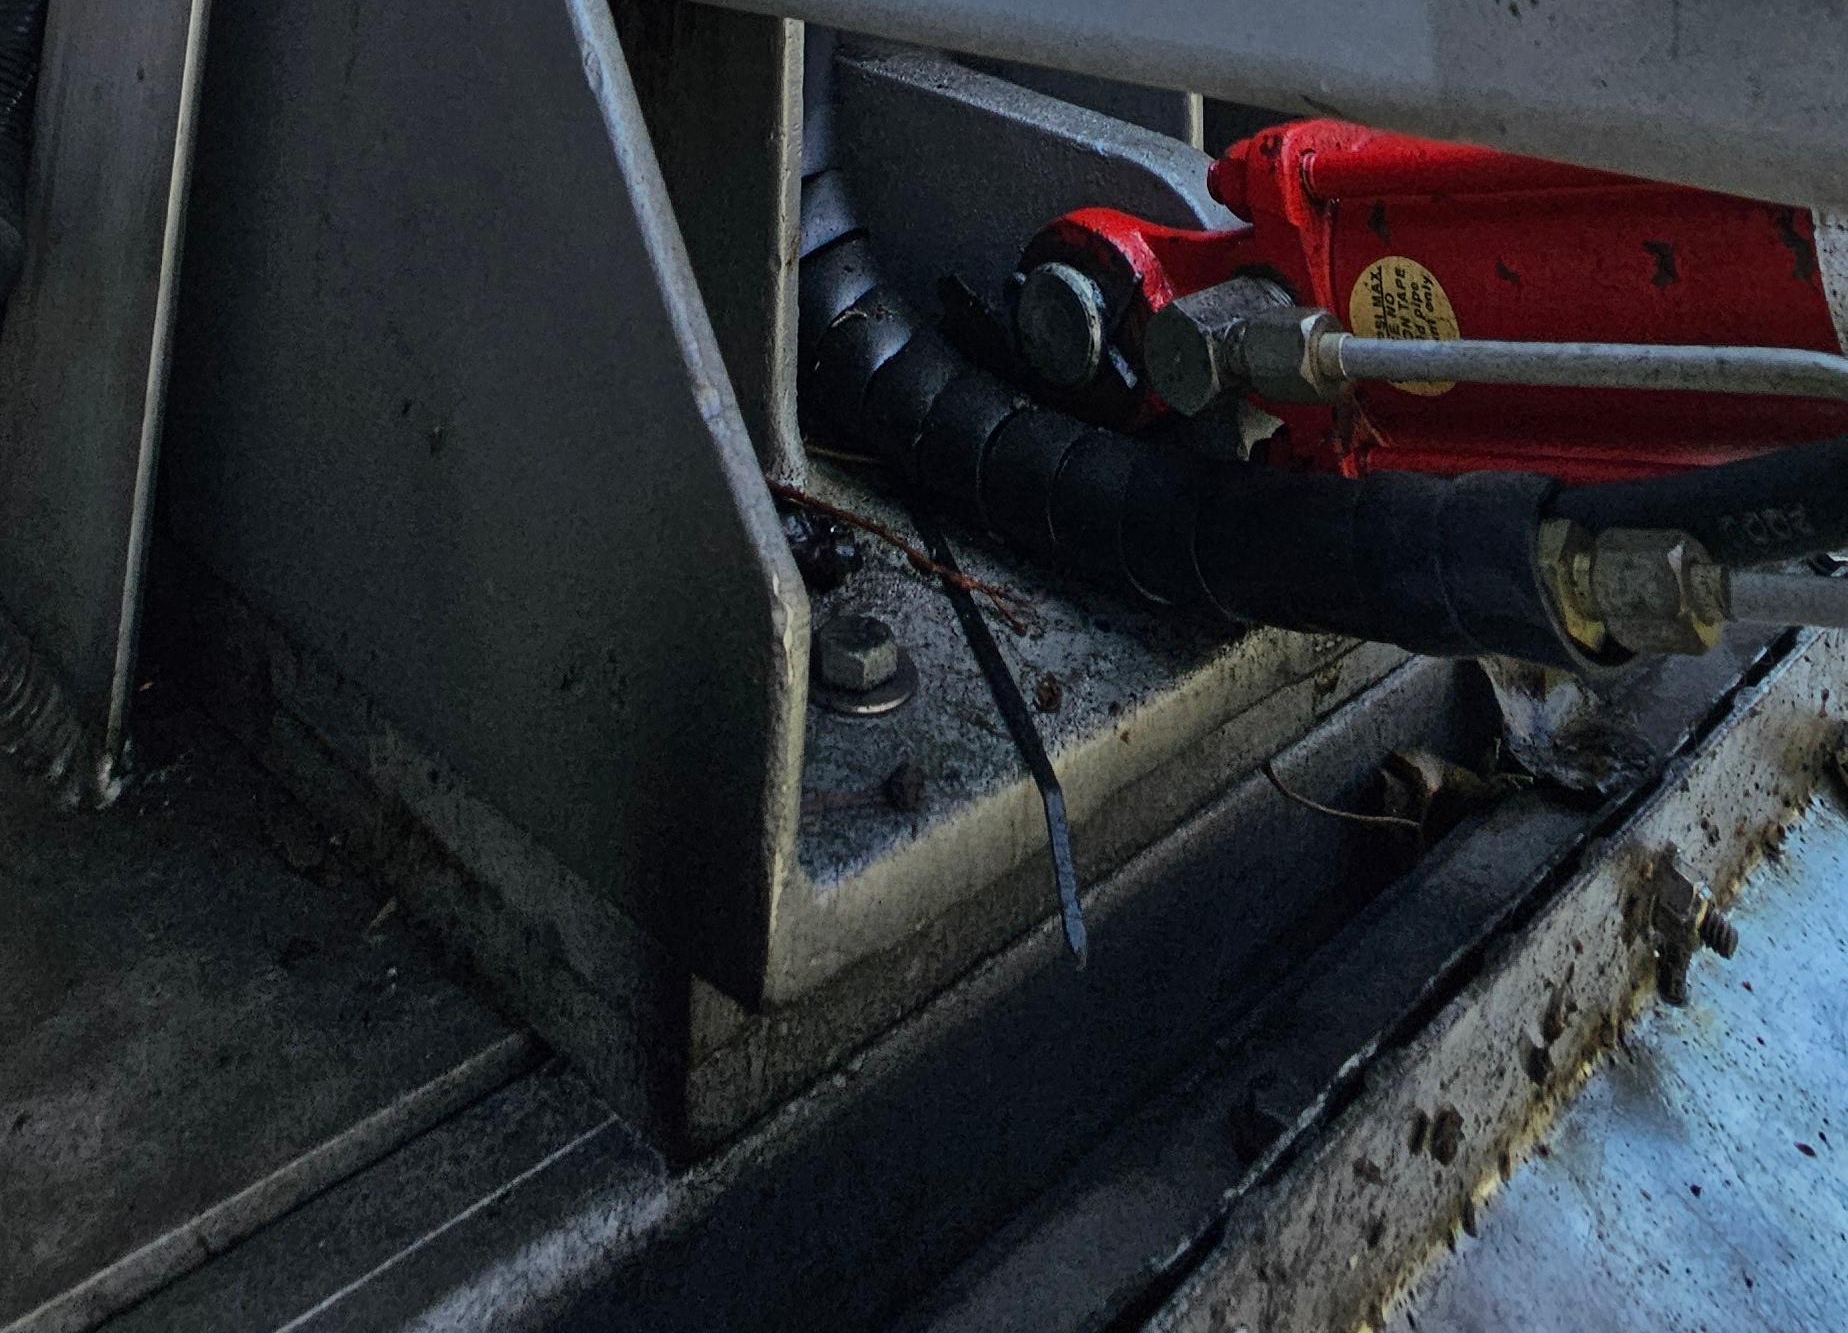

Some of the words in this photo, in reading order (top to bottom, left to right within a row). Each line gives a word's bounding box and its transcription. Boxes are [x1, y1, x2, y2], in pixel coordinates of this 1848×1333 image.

[1384, 293, 1397, 319] NO
[1395, 267, 1409, 310] TAPE
[1410, 282, 1427, 321] pipe
